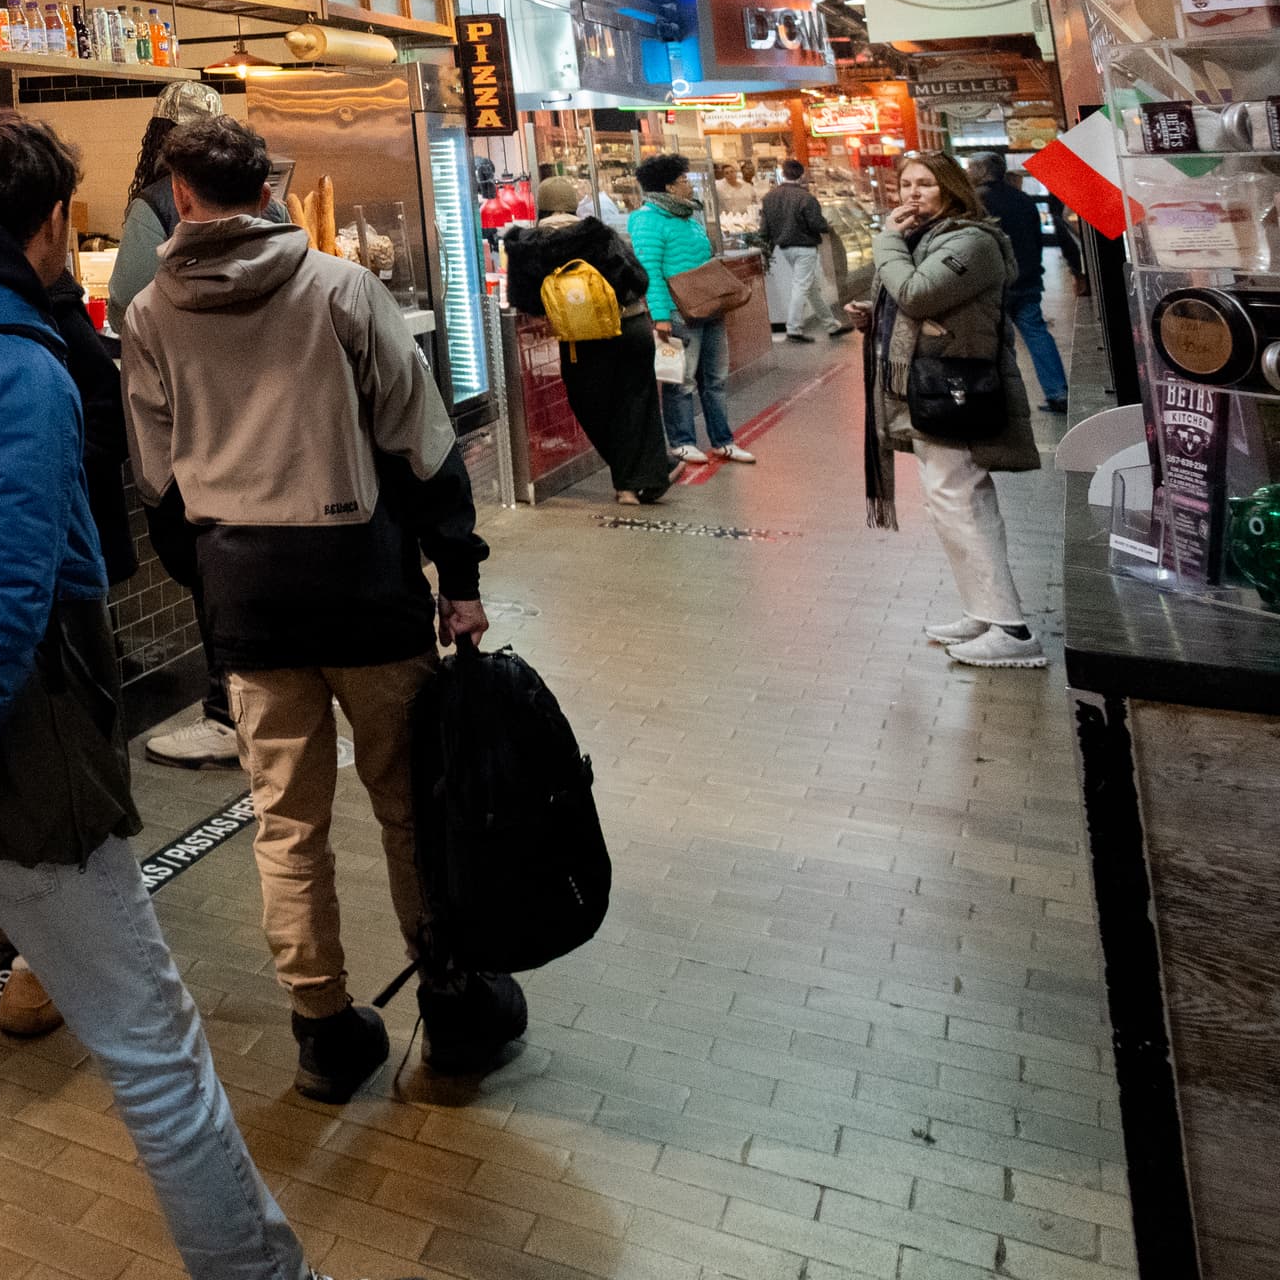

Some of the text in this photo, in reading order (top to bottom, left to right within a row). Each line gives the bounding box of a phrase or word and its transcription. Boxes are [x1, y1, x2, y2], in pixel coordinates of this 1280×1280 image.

[466, 23, 505, 131] PIZZA
[914, 78, 1010, 95] MUELLER
[1172, 413, 1209, 428] KITCHEN
[172, 818, 234, 861] PASTAS
